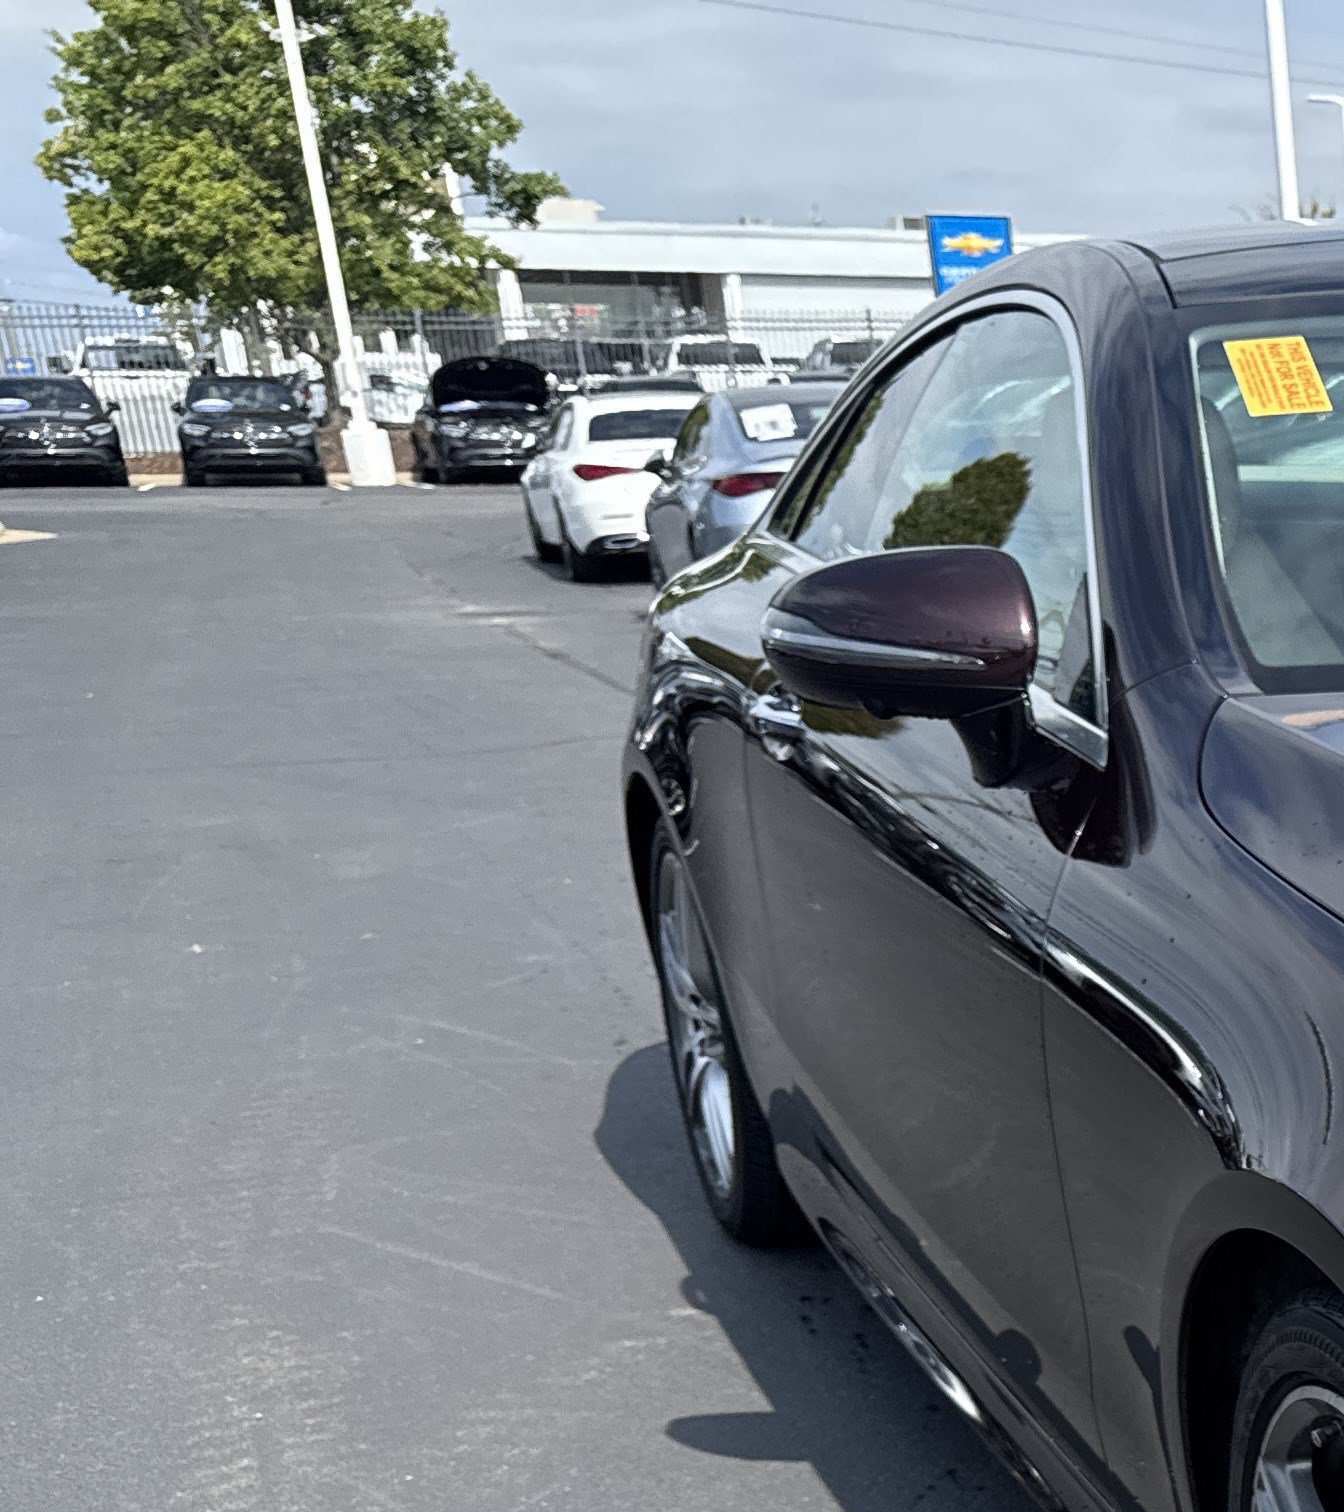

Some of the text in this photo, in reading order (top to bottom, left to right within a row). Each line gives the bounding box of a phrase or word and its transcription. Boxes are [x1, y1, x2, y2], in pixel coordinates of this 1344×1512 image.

[1274, 360, 1295, 382] FOR
[1282, 383, 1307, 409] SALE
[1296, 364, 1326, 408] VEHICLE
